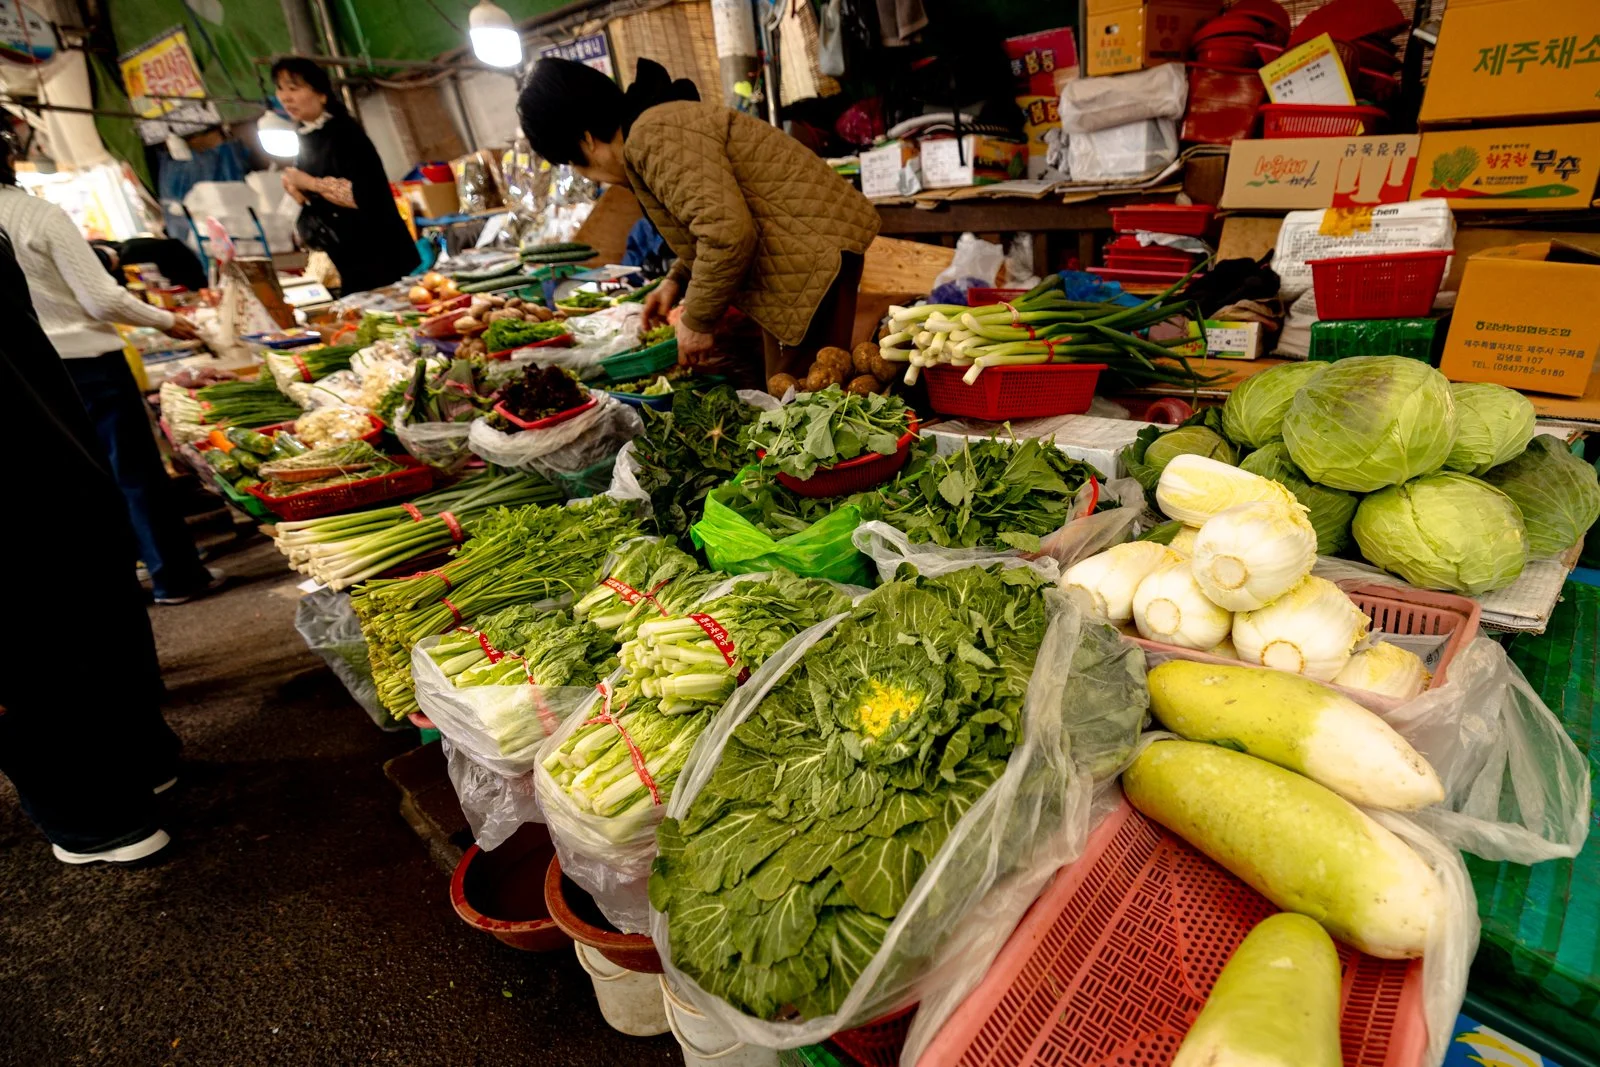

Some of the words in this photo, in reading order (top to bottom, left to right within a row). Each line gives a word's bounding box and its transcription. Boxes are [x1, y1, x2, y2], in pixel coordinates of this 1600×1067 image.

[1530, 149, 1582, 182] 부추
[1464, 339, 1524, 353] 제주특별자치도
[1526, 346, 1555, 355] 제주시
[1557, 348, 1585, 359] 구좌읍
[1496, 352, 1522, 363] 김녕로
[1526, 356, 1544, 365] 107
